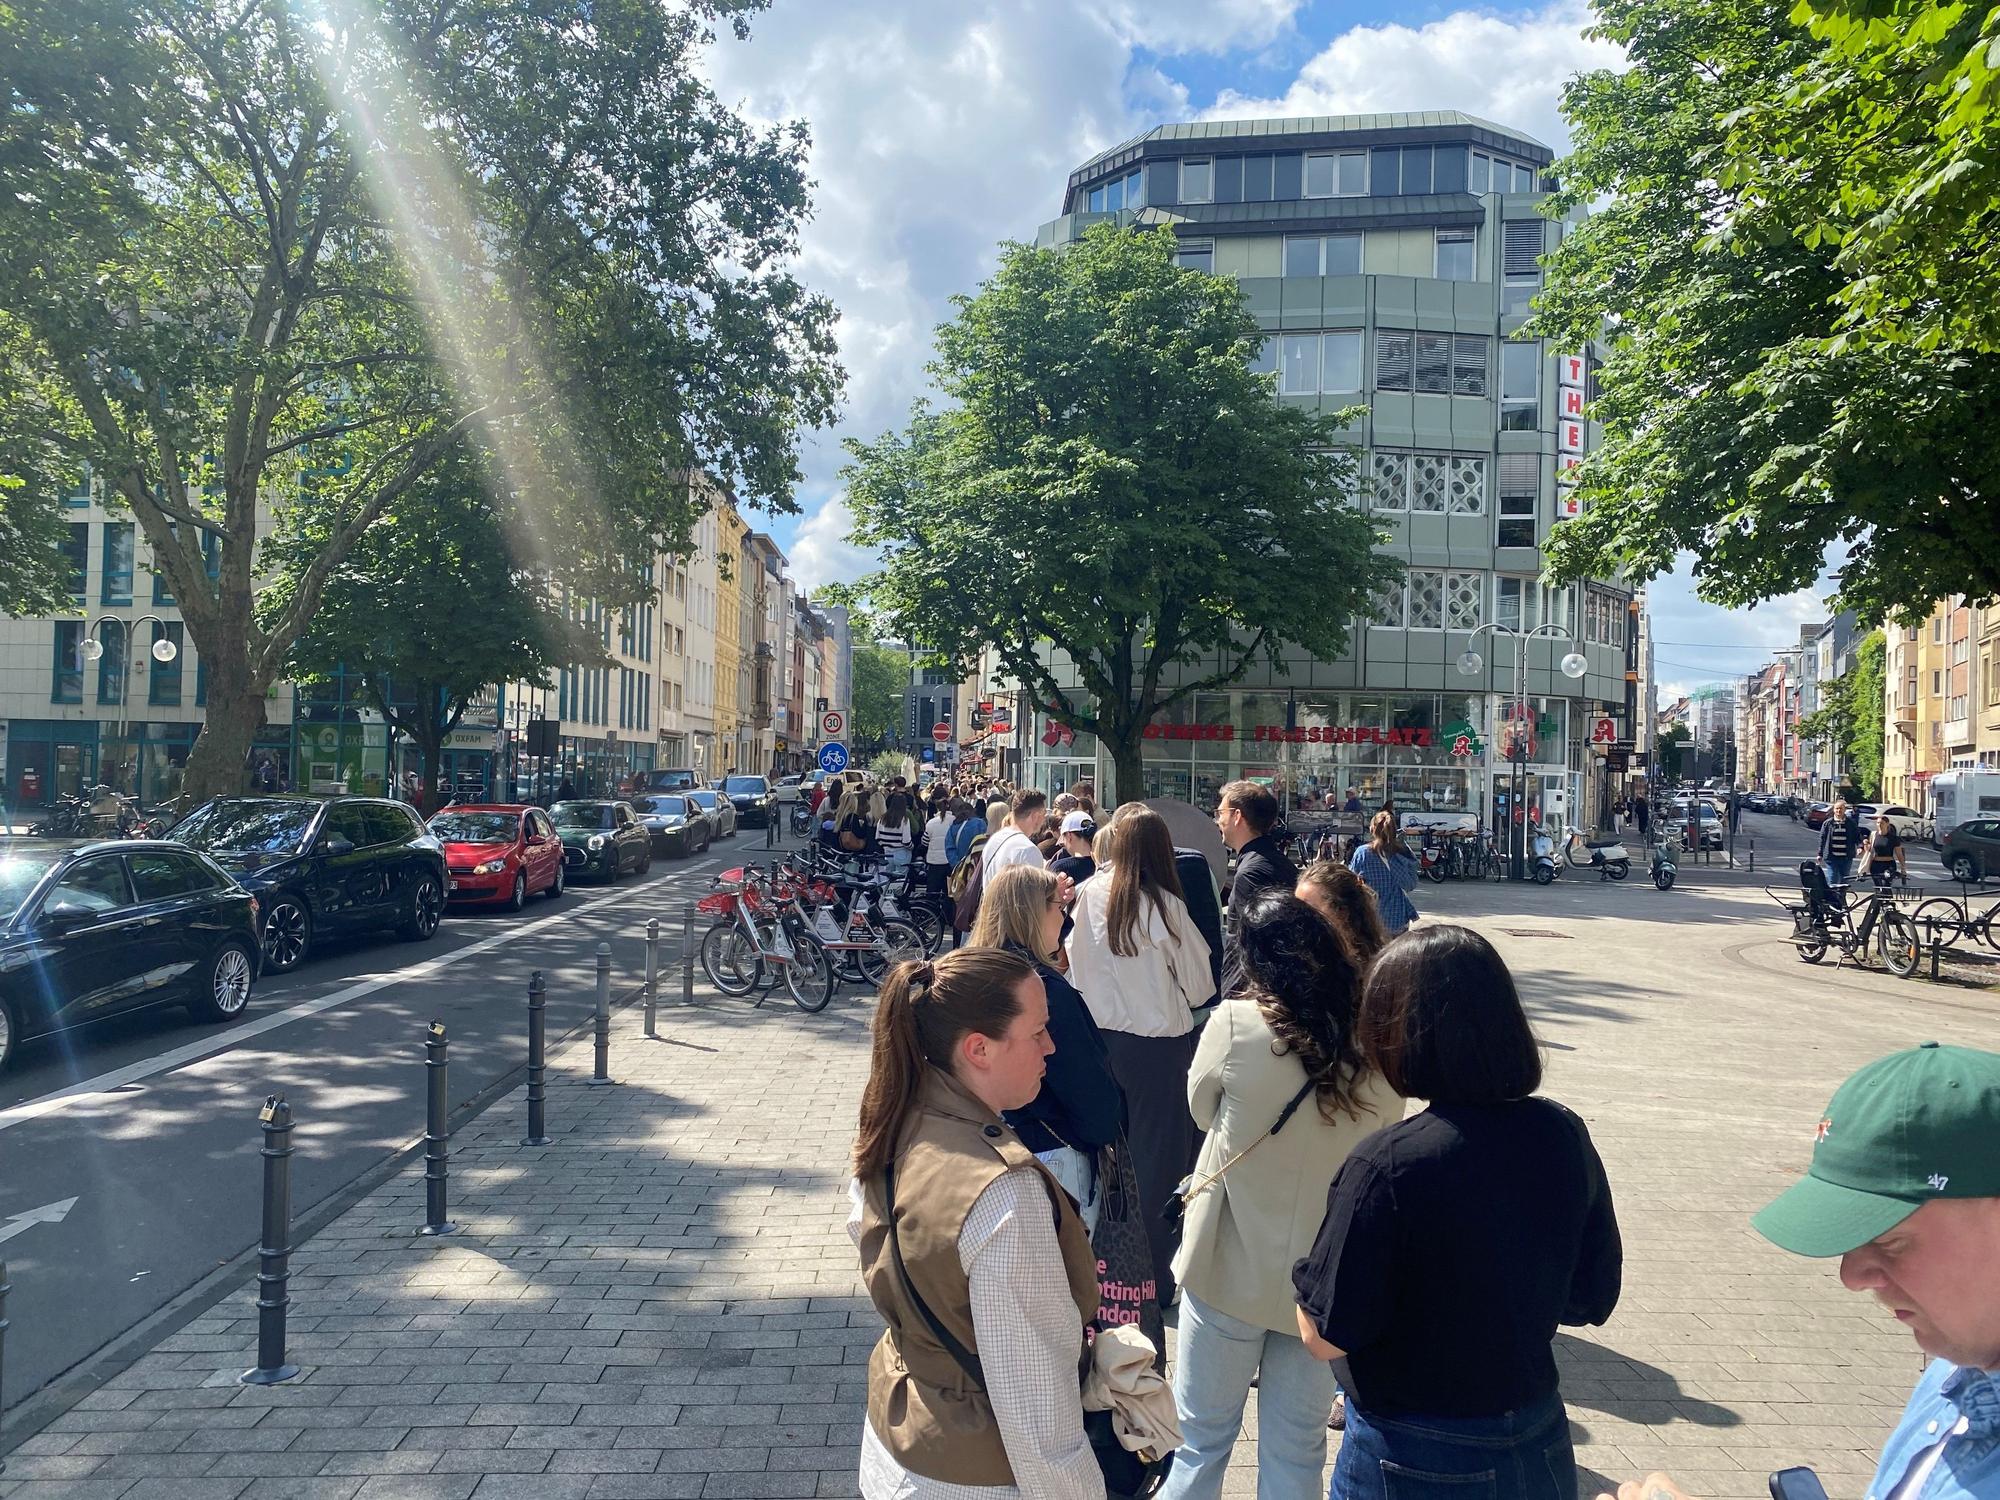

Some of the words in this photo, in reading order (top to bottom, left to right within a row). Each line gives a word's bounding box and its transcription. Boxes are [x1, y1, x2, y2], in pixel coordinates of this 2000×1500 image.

[1567, 359, 1581, 514] THEKE
[827, 718, 839, 728] 30
[344, 735, 379, 745] OXFAM
[455, 734, 481, 743] OXFAM
[1142, 1280, 1156, 1300] Hill
[1097, 1303, 1141, 1324] ndon
